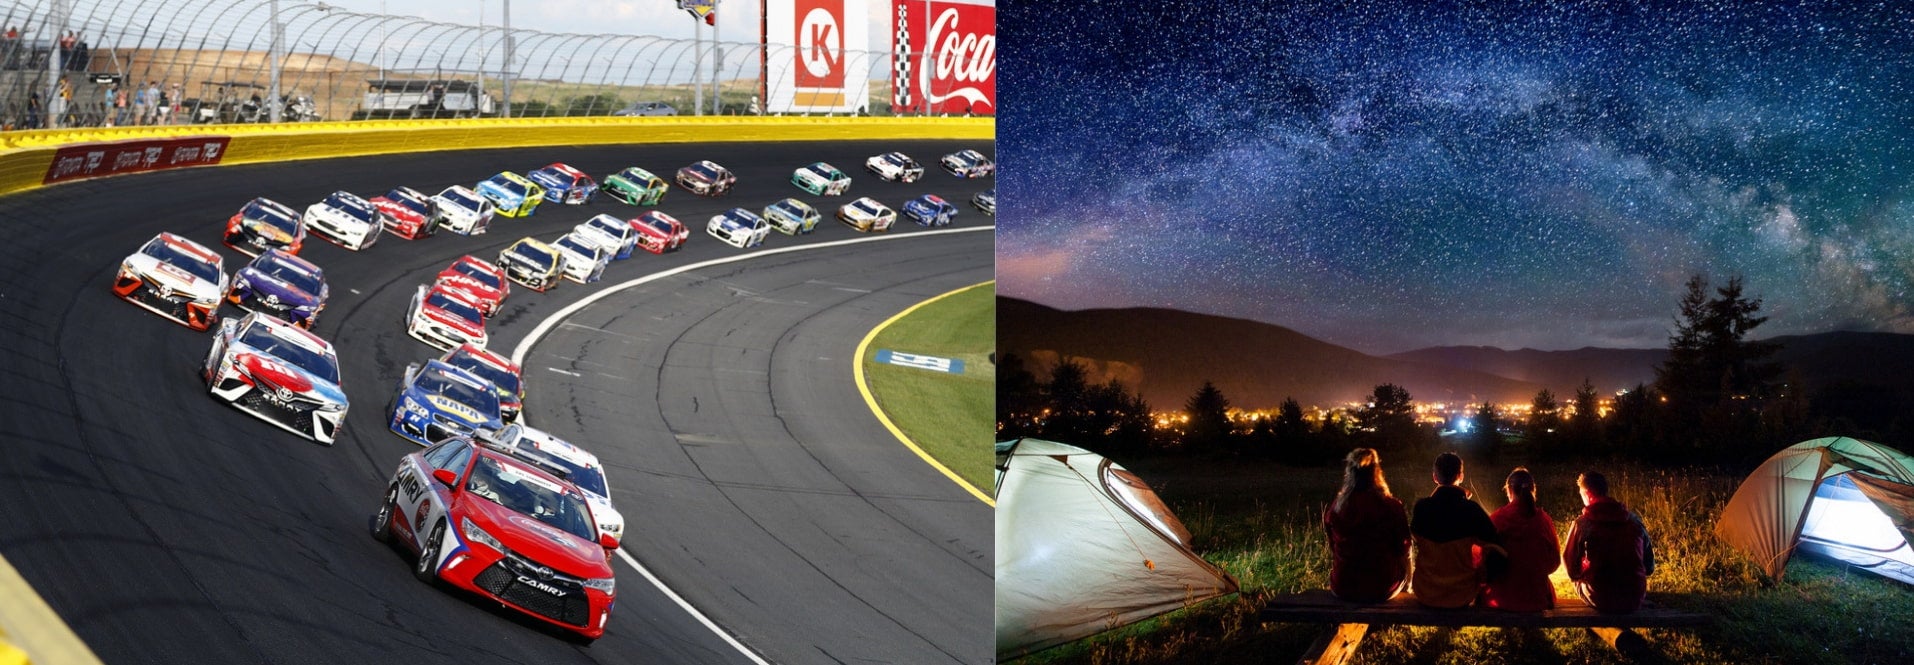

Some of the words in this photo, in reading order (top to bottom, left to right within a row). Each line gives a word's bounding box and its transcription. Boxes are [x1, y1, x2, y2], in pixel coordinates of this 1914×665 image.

[811, 23, 836, 72] K
[920, 8, 995, 107] Coca
[436, 397, 479, 419] NAPA
[517, 575, 567, 597] CAMRY
